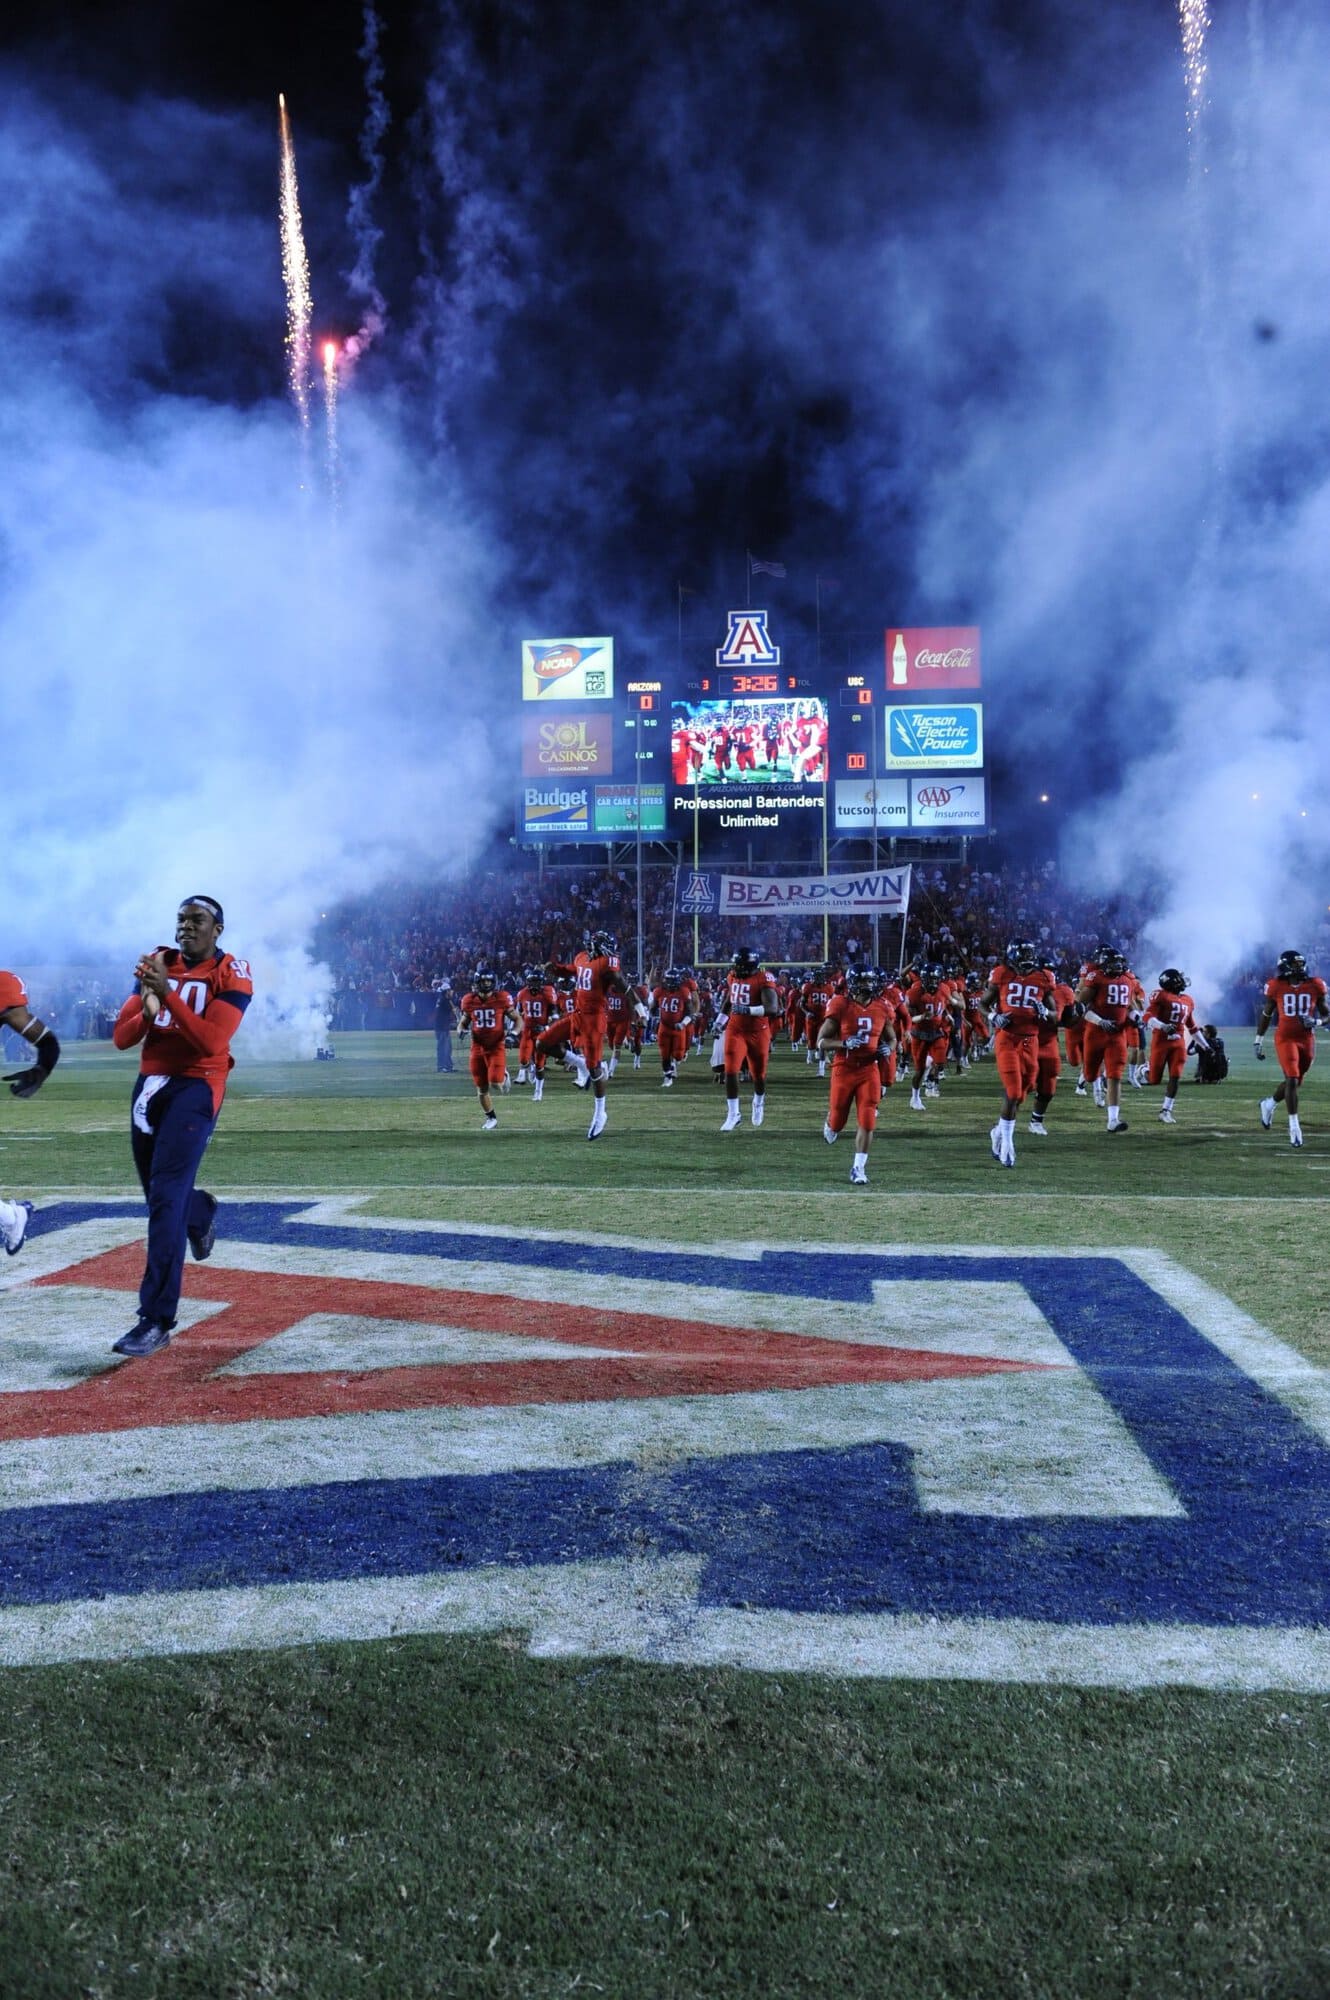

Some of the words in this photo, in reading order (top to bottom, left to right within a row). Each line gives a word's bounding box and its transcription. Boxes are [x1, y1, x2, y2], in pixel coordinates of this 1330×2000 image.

[716, 611, 780, 667] A
[541, 658, 573, 671] NCAA
[914, 648, 975, 668] Coca-Cola
[627, 682, 661, 692] ARIZONA
[702, 679, 710, 691] 3
[733, 675, 777, 692] 3:26
[788, 677, 796, 689] 3
[848, 676, 865, 686] USC
[640, 695, 653, 709] 0
[911, 714, 957, 727] Tucson
[539, 721, 597, 750] SOL
[916, 726, 969, 738] Electric
[921, 738, 969, 750] Power
[539, 750, 598, 763] CASINOS
[525, 787, 588, 810] Budget
[633, 797, 664, 805] CNTERS
[674, 796, 753, 810] Professional
[756, 795, 825, 808] Bartenders
[920, 787, 948, 808] AAA
[838, 805, 907, 815] tucson.com
[934, 810, 980, 819] Insurance
[720, 814, 779, 828] Unlimited
[576, 966, 593, 991] 18
[730, 983, 750, 1005] 95
[1007, 983, 1038, 1009] 26
[1107, 984, 1129, 1005] 92
[525, 1001, 542, 1017] 19
[661, 998, 679, 1013] 46
[1283, 994, 1311, 1016] 80
[473, 1010, 496, 1029] 35
[1169, 1003, 1189, 1023] 27
[857, 1017, 872, 1044] 2
